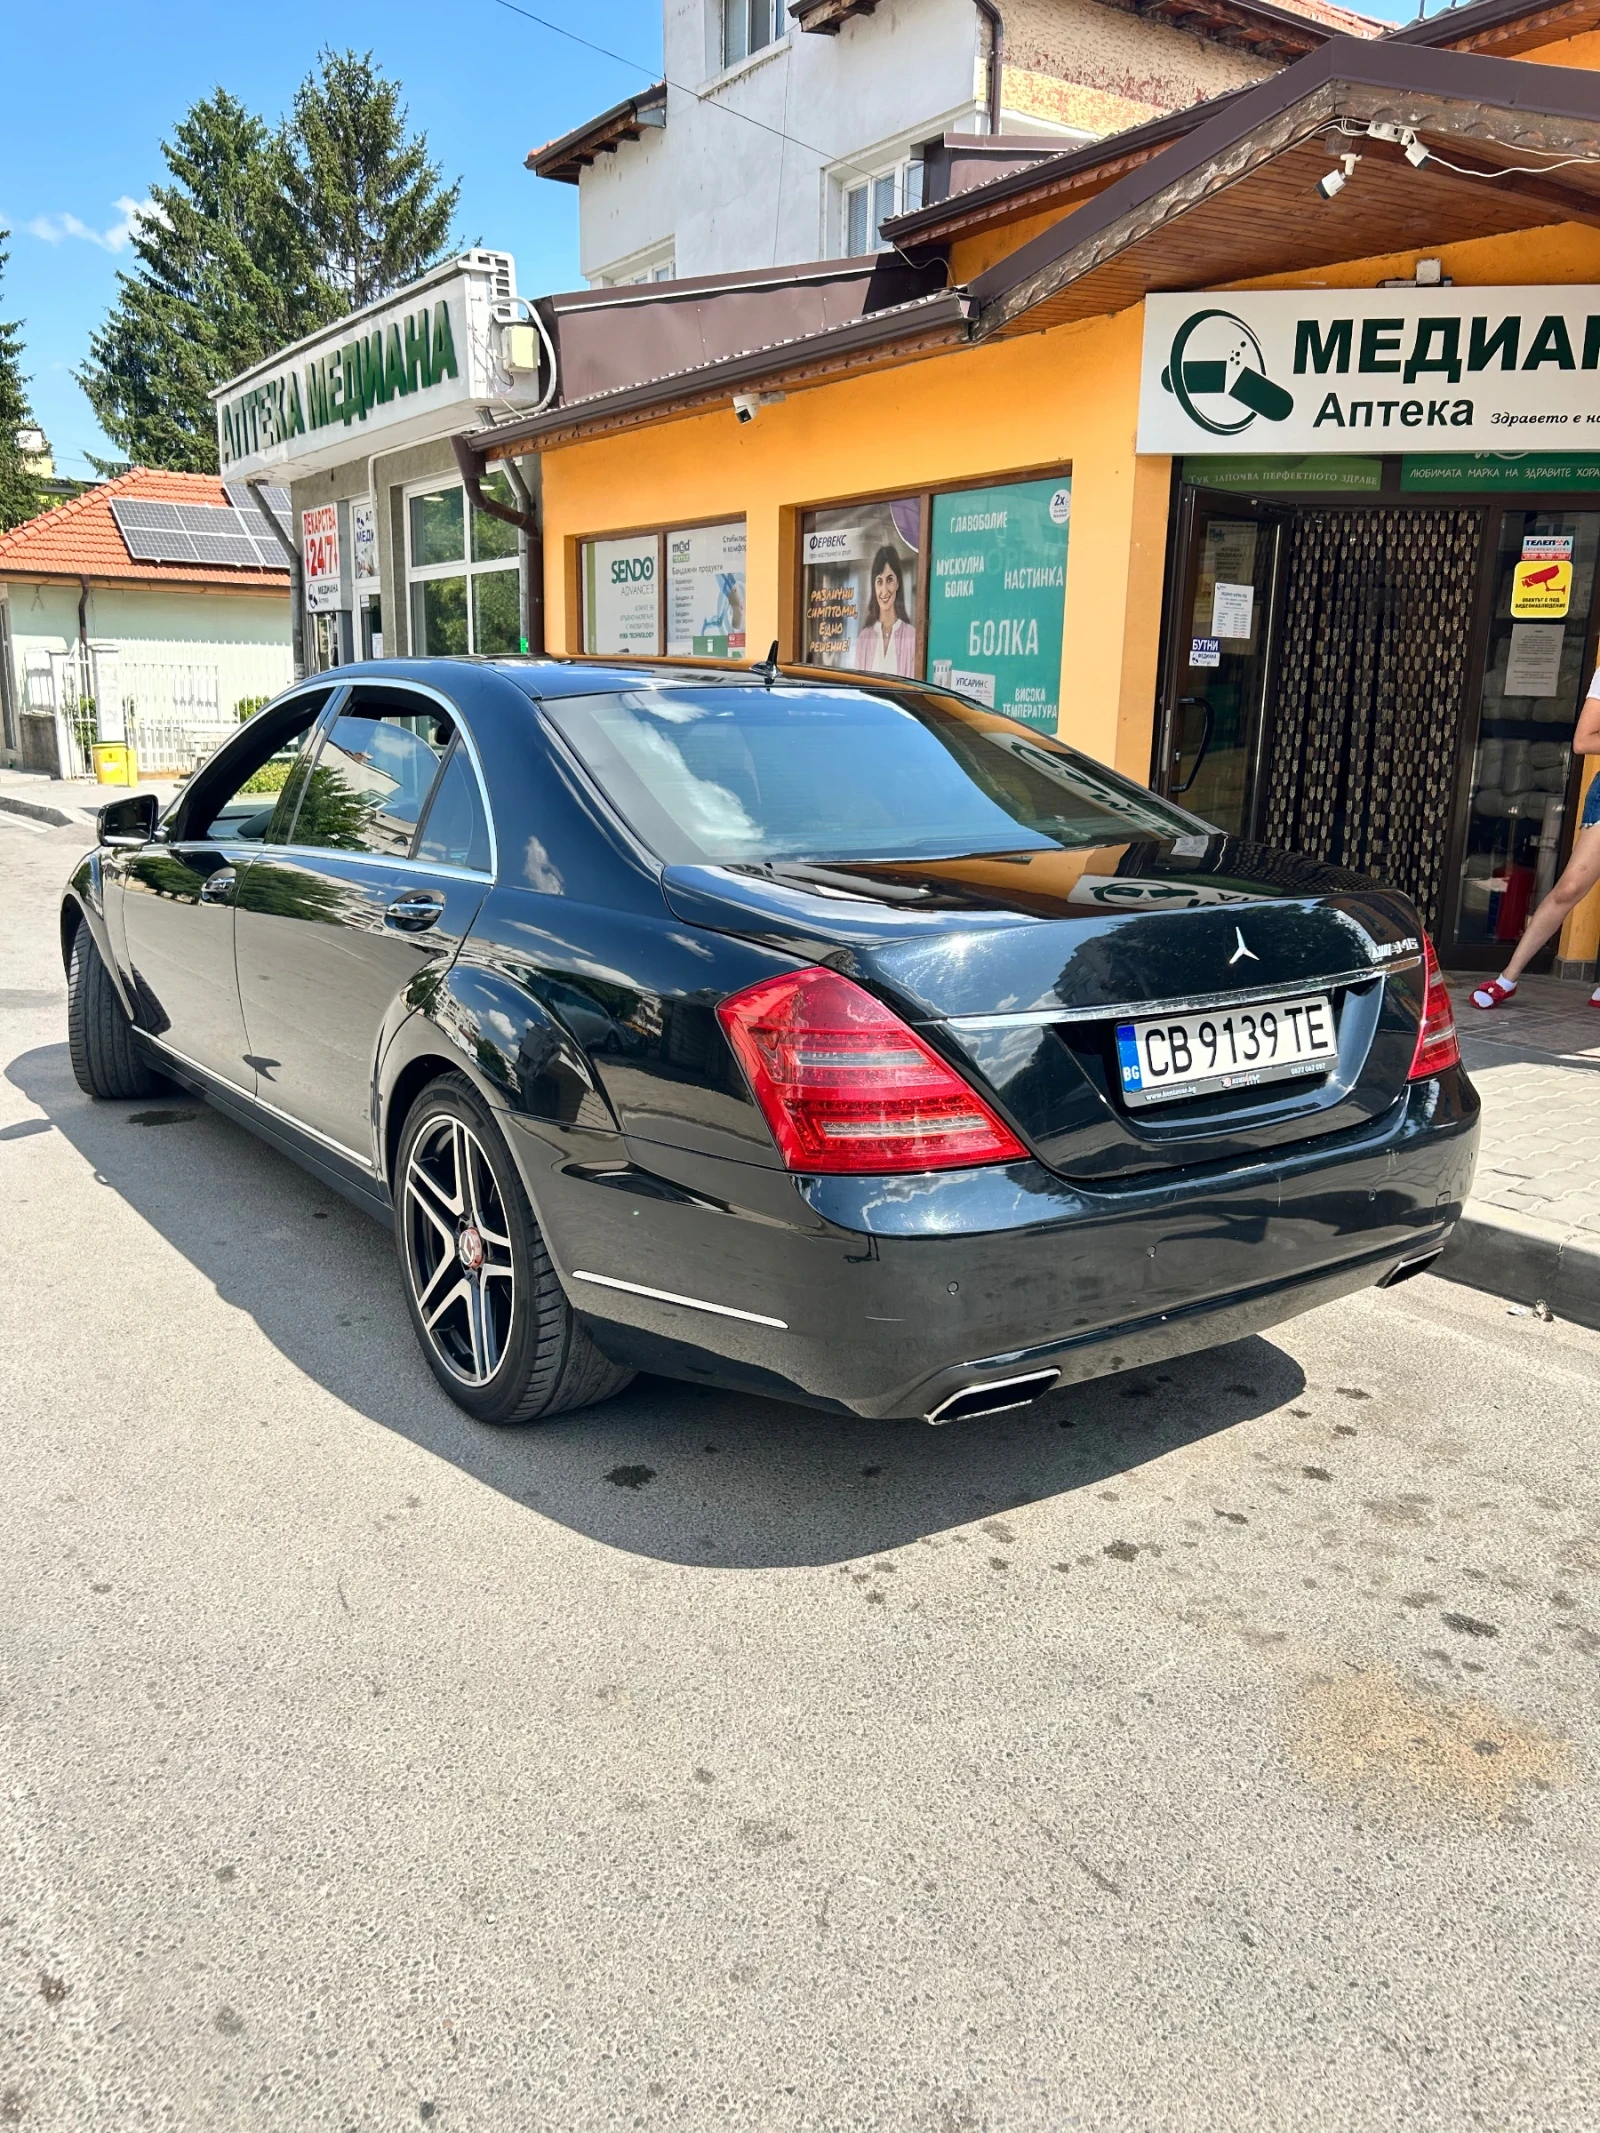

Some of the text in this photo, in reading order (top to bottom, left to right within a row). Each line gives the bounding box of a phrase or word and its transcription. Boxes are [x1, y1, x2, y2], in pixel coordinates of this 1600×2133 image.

[221, 300, 459, 464] АПТЕКА МЕДИАНА
[1312, 392, 1475, 428] Аптека
[1490, 411, 1568, 427] Здравето
[1573, 414, 1582, 424] е
[1213, 472, 1259, 483] ЗАПОЧВА
[1263, 470, 1337, 481] ПЕРФЕКТНОТО
[1340, 474, 1377, 485] ЗДРАВЕ
[1410, 468, 1462, 478] ЛЮБИМАТА
[1467, 468, 1500, 478] МАРКА
[1505, 468, 1518, 478] НА
[1524, 467, 1572, 479] ЗДРАВИТЕ
[303, 504, 337, 537] ЛЕКАРСТВА
[950, 511, 1008, 534] ГЛАВОБОЛИЕ
[809, 534, 847, 551] ФЕРВЕКС
[310, 534, 335, 577] 24/7
[611, 556, 654, 584] SENDO
[672, 564, 724, 575] Бандажни продукти
[936, 556, 985, 576] МУСКУЛНА
[1004, 565, 1064, 590] НАСТИНКА
[317, 583, 339, 595] МЕДИАНА
[621, 585, 651, 596] ADVANCE
[811, 587, 854, 602] РАЗЛИЧНИ
[945, 579, 974, 598] БОЛКА
[807, 604, 858, 619] СИМПТОМИ,
[819, 621, 843, 637] ЕДНО
[969, 618, 1039, 656] БОЛКА
[809, 637, 850, 653] РЕШЕНИЕ!
[1192, 638, 1219, 651] БУТНИ
[955, 677, 983, 689] УПСАРИН
[1014, 687, 1046, 702] ВИСОКА
[1002, 703, 1058, 719] ТЕМПЕРАТУРА
[1145, 1004, 1329, 1077] CB 9139 TE
[1122, 1065, 1140, 1082] BG
